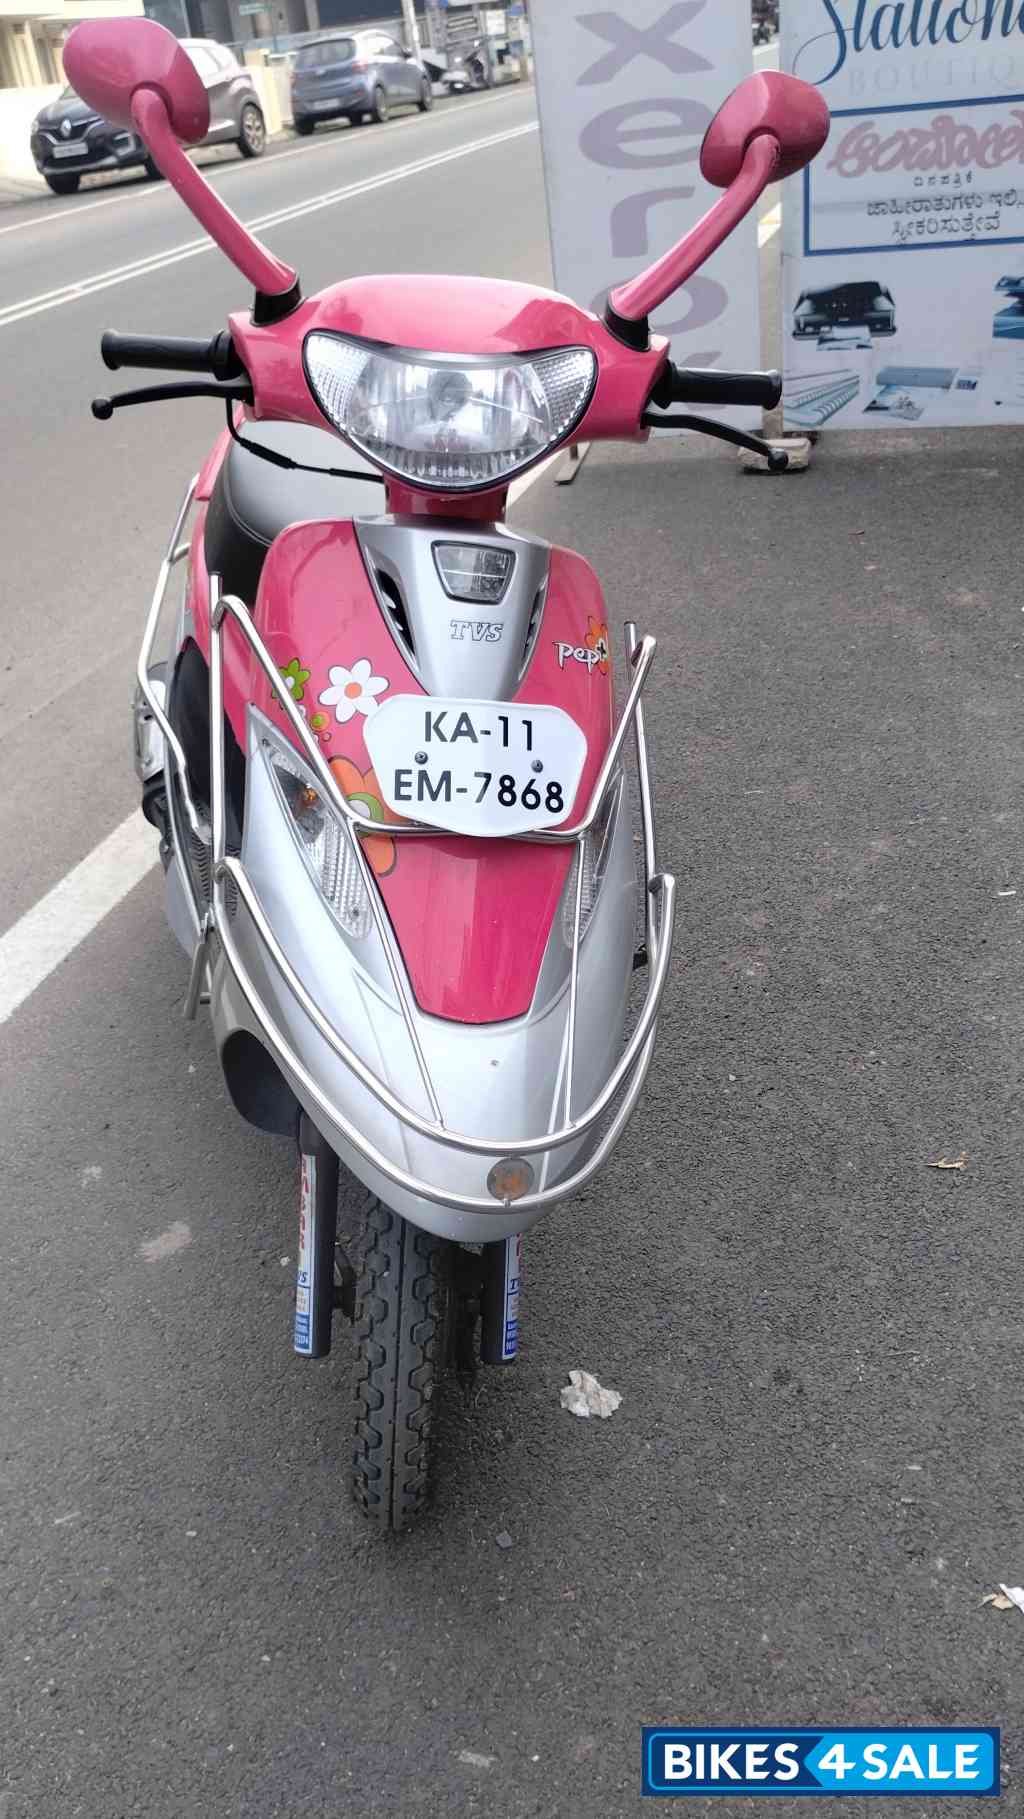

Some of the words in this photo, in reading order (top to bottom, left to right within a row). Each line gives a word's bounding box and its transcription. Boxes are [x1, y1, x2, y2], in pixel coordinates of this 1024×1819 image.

[573, 0, 729, 410] xero
[449, 619, 503, 643] TVS
[424, 710, 533, 752] KA-11
[393, 768, 564, 814] EM-7868
